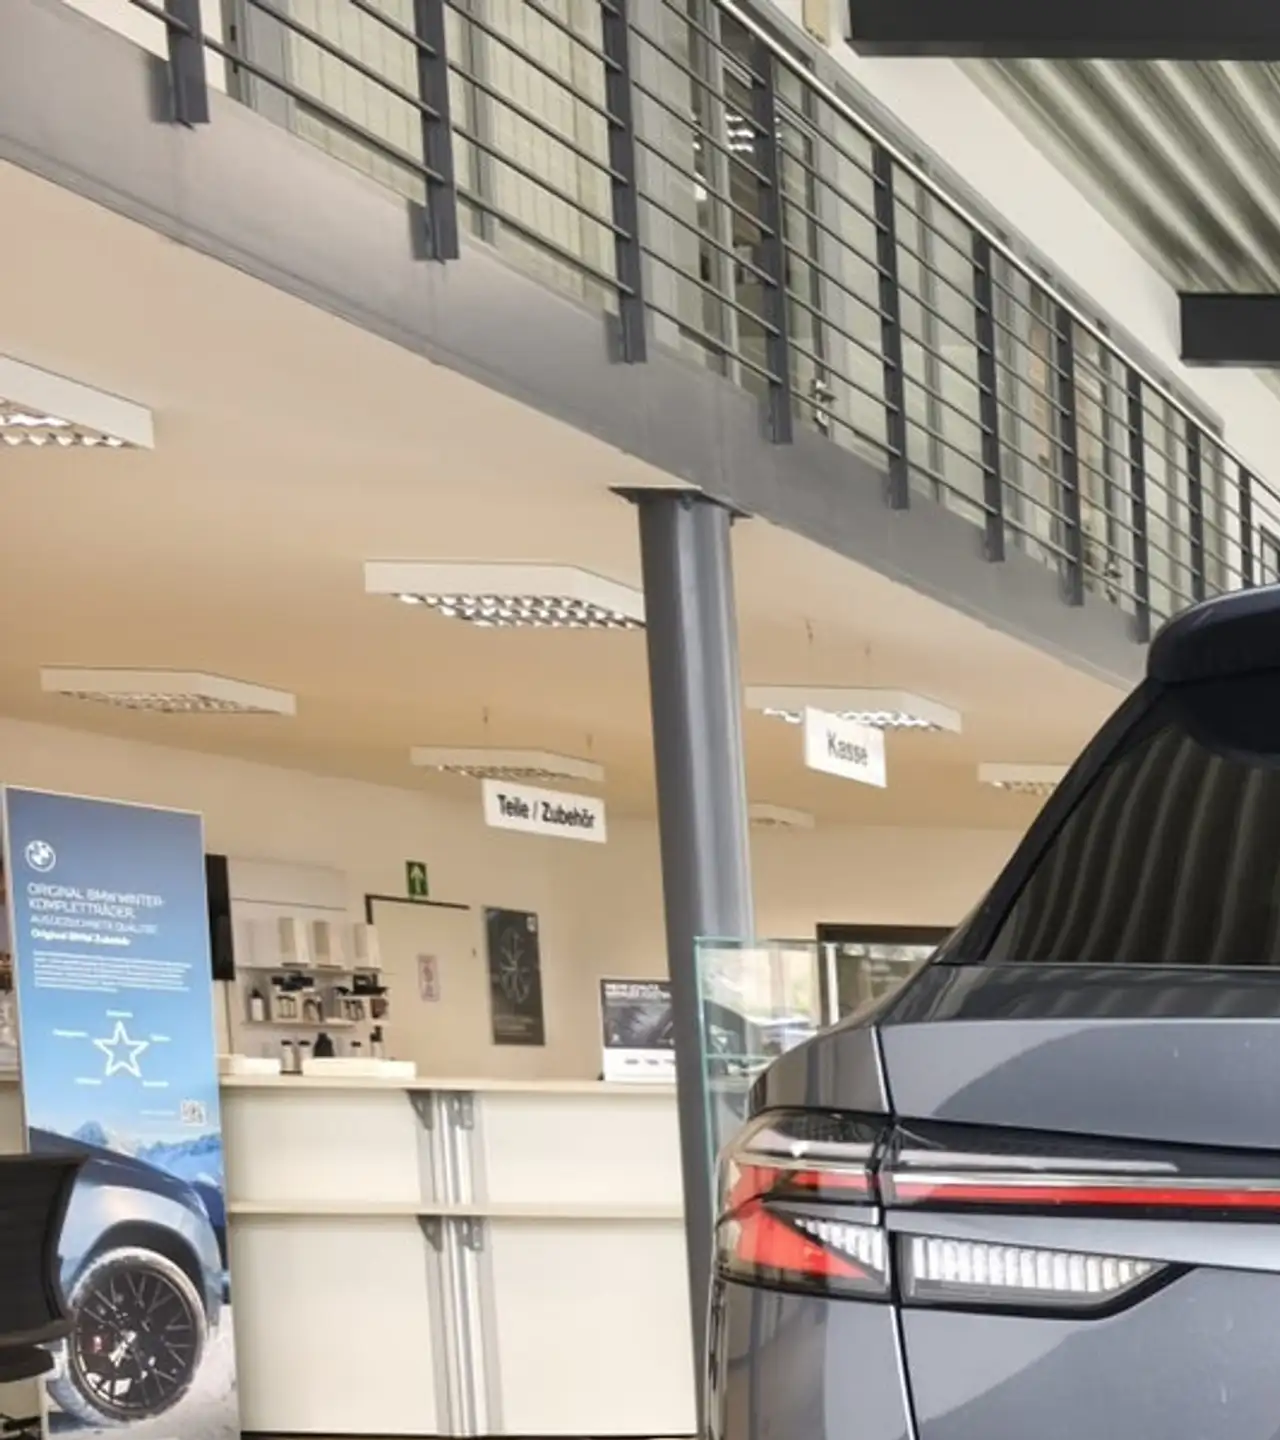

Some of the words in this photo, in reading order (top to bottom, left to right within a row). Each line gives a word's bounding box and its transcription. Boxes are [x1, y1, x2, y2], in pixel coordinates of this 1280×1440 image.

[826, 728, 868, 767] Kasse
[497, 794, 529, 819] Teile
[532, 801, 539, 820] /
[541, 801, 595, 829] Zubehör
[27, 882, 84, 900] ORIGINAL
[30, 928, 67, 941] Original
